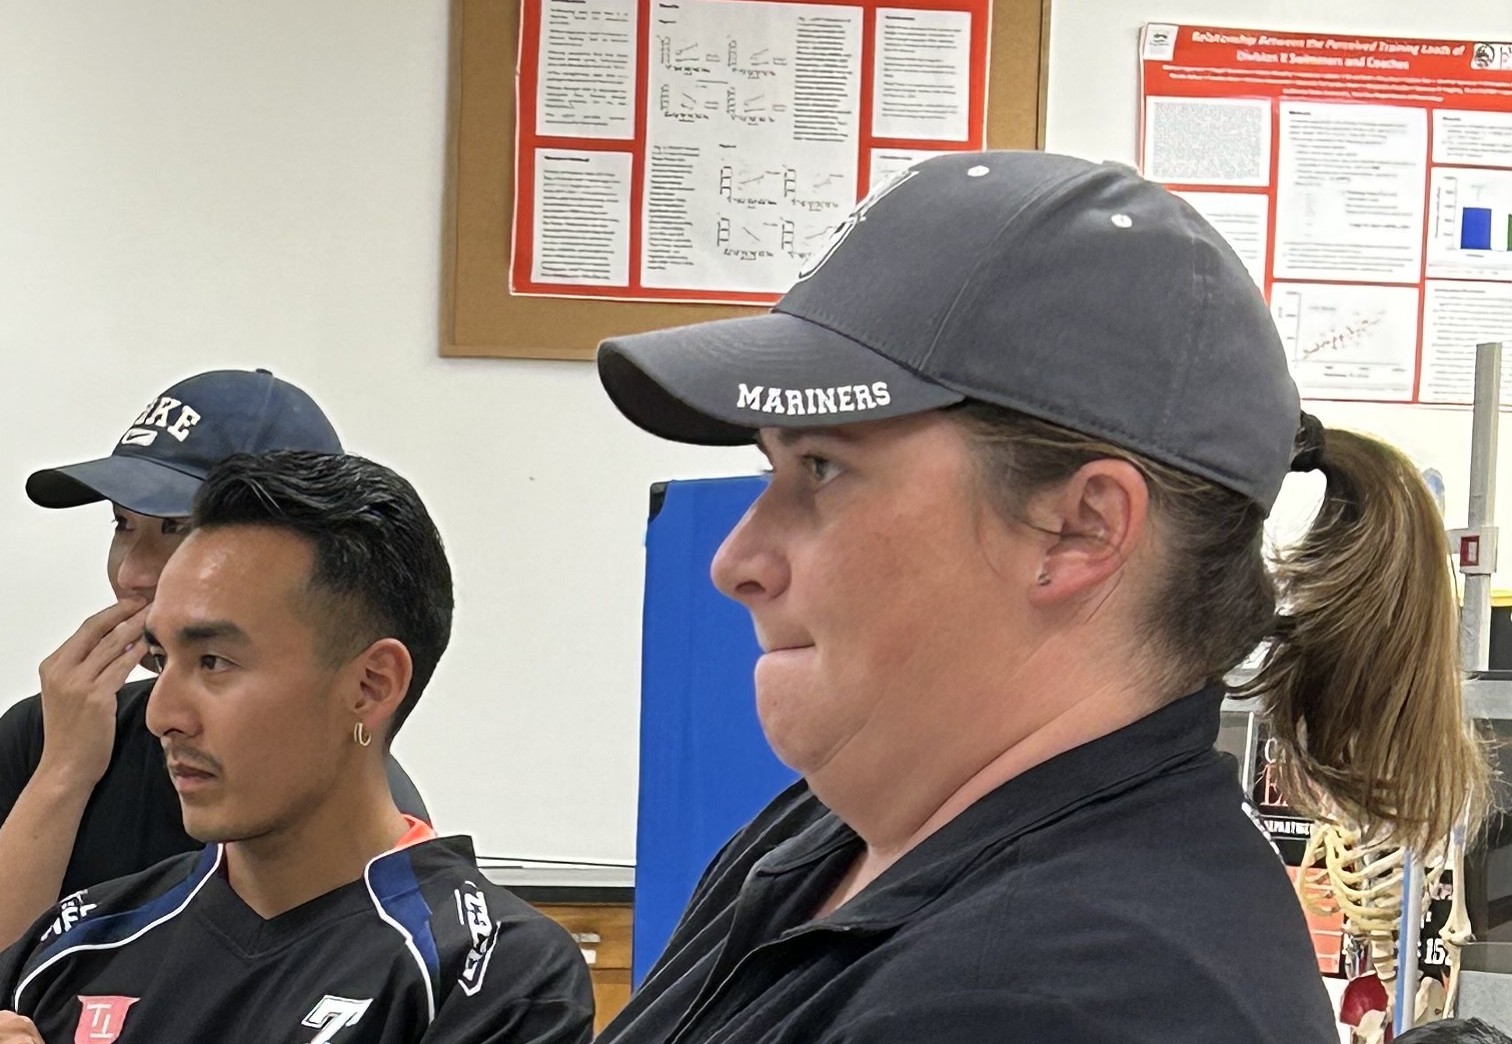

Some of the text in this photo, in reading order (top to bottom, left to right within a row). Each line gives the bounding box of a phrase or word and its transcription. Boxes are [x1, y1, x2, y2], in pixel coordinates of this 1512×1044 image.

[1379, 41, 1420, 55] Training
[1344, 56, 1366, 69] and
[736, 381, 891, 416] MARINERS
[134, 397, 202, 443] KE
